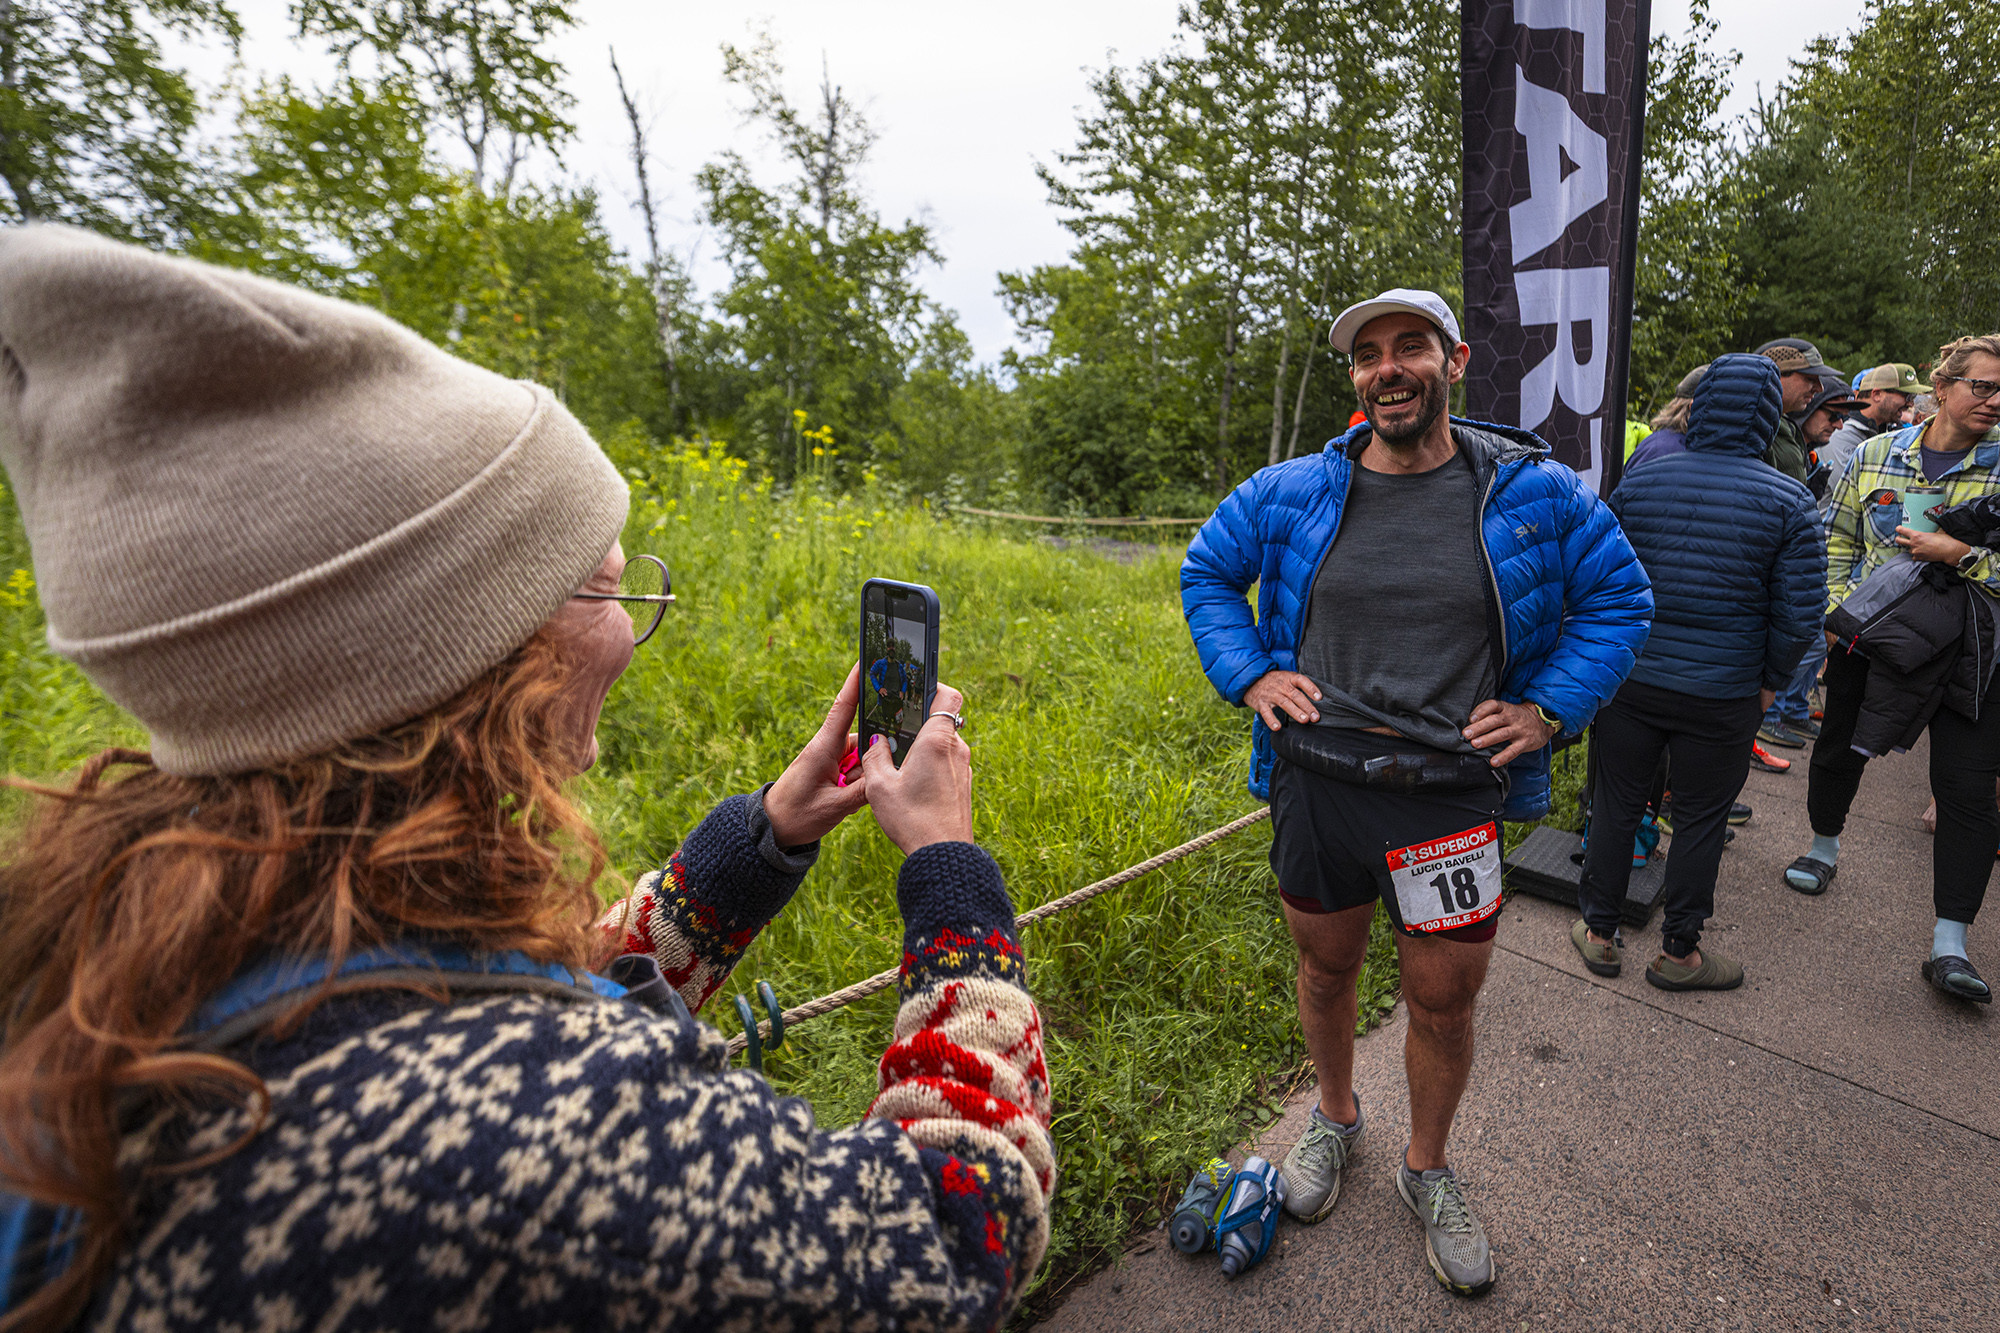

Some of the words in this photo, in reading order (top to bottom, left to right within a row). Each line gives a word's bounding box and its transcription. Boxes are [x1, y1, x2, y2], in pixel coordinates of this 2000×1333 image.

[1418, 830, 1488, 860] SUPERIOR
[1411, 862, 1442, 877] LUCIO
[1445, 850, 1485, 868] BAVELLI
[1429, 867, 1480, 914] 18
[1419, 920, 1440, 931] 100
[1442, 914, 1471, 928] MILE
[1479, 901, 1497, 919] 2025
